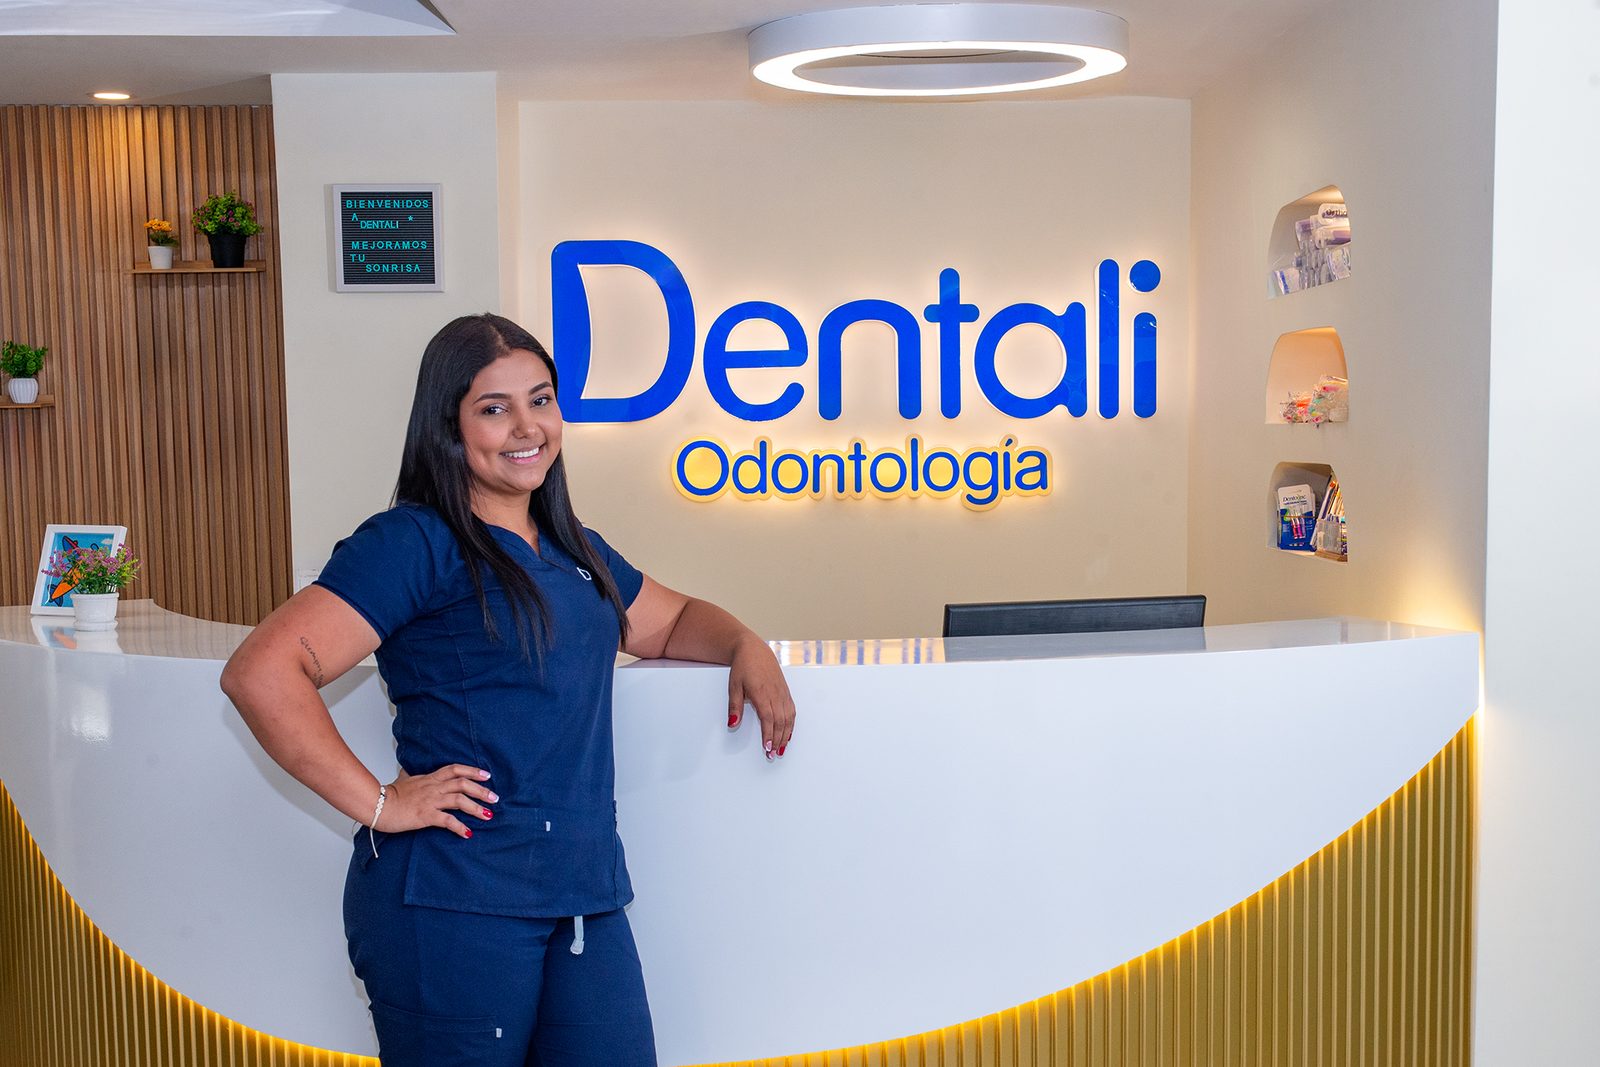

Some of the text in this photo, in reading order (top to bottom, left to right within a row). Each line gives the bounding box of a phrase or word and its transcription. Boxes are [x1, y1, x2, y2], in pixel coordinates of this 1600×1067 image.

[346, 199, 429, 209] BIENVENIDOS
[351, 212, 359, 221] A
[359, 220, 399, 229] DENTALI
[351, 240, 427, 250] MEJORAMOS
[350, 253, 366, 263] TU
[365, 263, 421, 273] SONRISA
[551, 239, 1162, 423] Dentali
[676, 437, 1048, 505] Odontología
